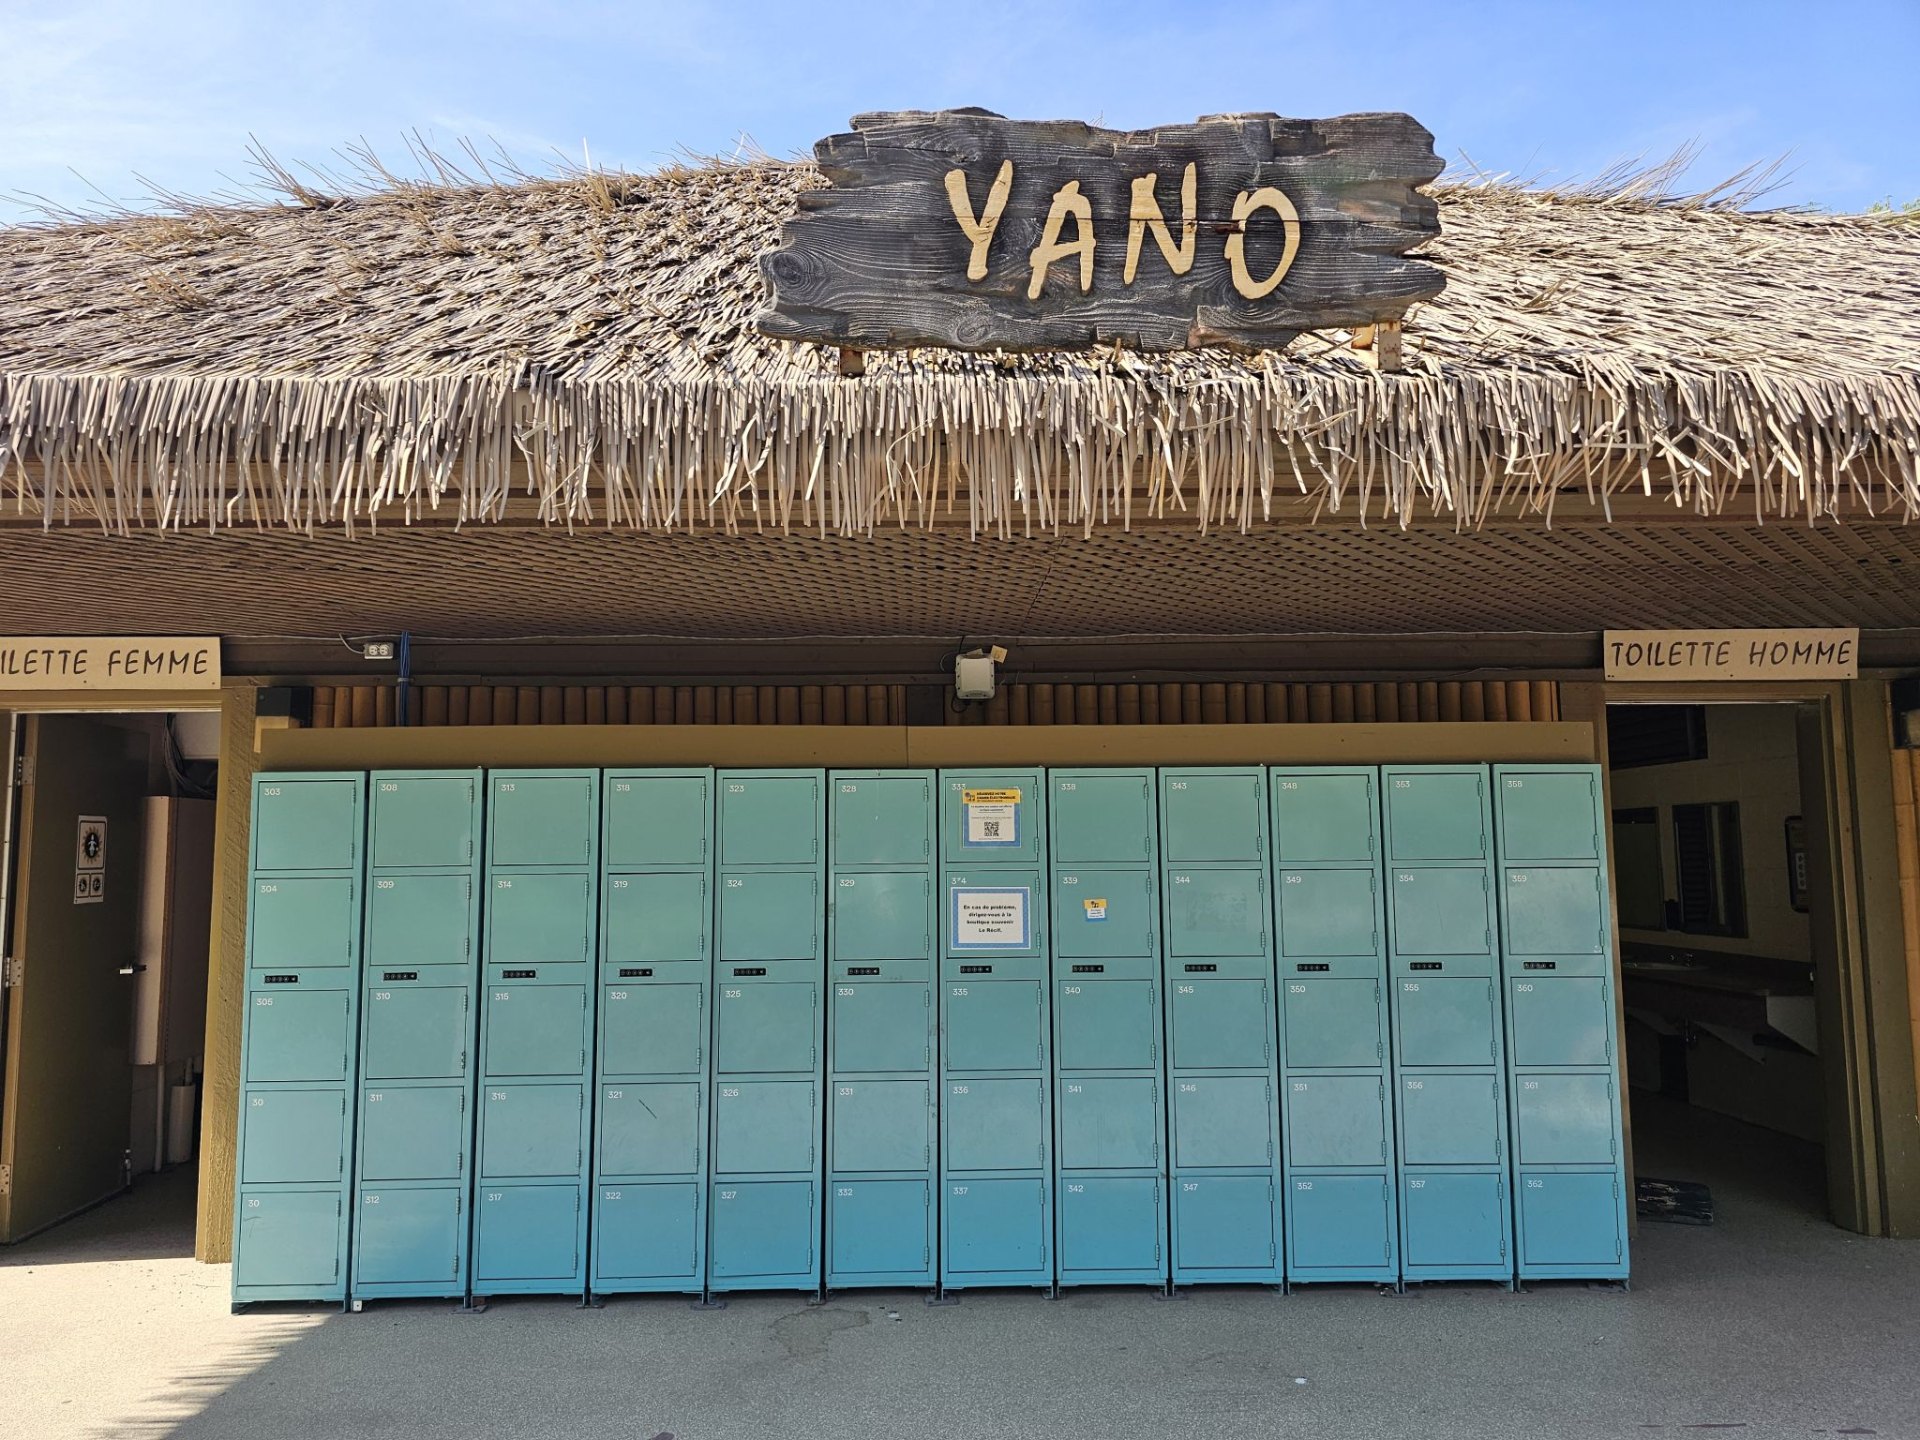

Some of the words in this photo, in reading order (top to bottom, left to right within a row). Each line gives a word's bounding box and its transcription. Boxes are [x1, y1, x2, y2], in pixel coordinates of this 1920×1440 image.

[944, 159, 1301, 300] YANO
[1611, 641, 1731, 668] TOILETTE
[1749, 639, 1852, 668] HOMME
[108, 648, 209, 677] FEMME
[380, 783, 398, 792] 308
[500, 783, 516, 792] 313
[616, 783, 630, 792] 318
[728, 784, 745, 793] 323
[840, 784, 857, 793] 328
[1060, 783, 1076, 791] 338
[1171, 782, 1187, 790] 343
[1281, 782, 1298, 790] 348
[1395, 780, 1411, 789] 353
[1507, 780, 1523, 788] 358
[263, 787, 281, 796] 303
[1062, 876, 1078, 885] 339
[1175, 876, 1191, 884] 344
[1285, 875, 1302, 884] 349
[1398, 874, 1414, 882] 354
[1512, 874, 1528, 883] 359
[376, 880, 395, 889] 309
[497, 880, 513, 889] 314
[613, 880, 628, 888] 319
[727, 879, 743, 888] 324
[839, 879, 855, 887] 329
[260, 885, 278, 893] 304
[838, 988, 854, 996] 330
[952, 988, 968, 996] 335
[1064, 986, 1081, 995] 340
[1178, 985, 1194, 994] 345
[1290, 984, 1306, 993] 350
[1403, 983, 1420, 992] 355
[1516, 984, 1534, 992] 360
[375, 991, 391, 1001] 310
[494, 992, 509, 1001] 315
[610, 991, 628, 1000] 320
[725, 989, 742, 998] 325
[255, 997, 273, 1006] 305
[952, 1085, 969, 1095] 336
[1068, 1085, 1082, 1093] 341
[1180, 1084, 1197, 1093] 346
[1293, 1083, 1308, 1092] 351
[1407, 1081, 1423, 1090] 356
[1524, 1081, 1539, 1090] 361
[607, 1090, 623, 1099] 321
[722, 1088, 739, 1097] 326
[839, 1087, 854, 1096] 331
[369, 1093, 383, 1102] 311
[491, 1092, 507, 1101] 316
[1183, 1183, 1199, 1192] 347
[1296, 1181, 1313, 1191] 352
[1410, 1180, 1426, 1189] 357
[1527, 1179, 1544, 1188] 362
[837, 1187, 853, 1197] 332
[953, 1186, 969, 1195] 337
[1067, 1184, 1084, 1193] 342
[364, 1195, 380, 1204] 312
[488, 1192, 503, 1202] 317
[605, 1191, 622, 1200] 322
[721, 1190, 737, 1200] 327
